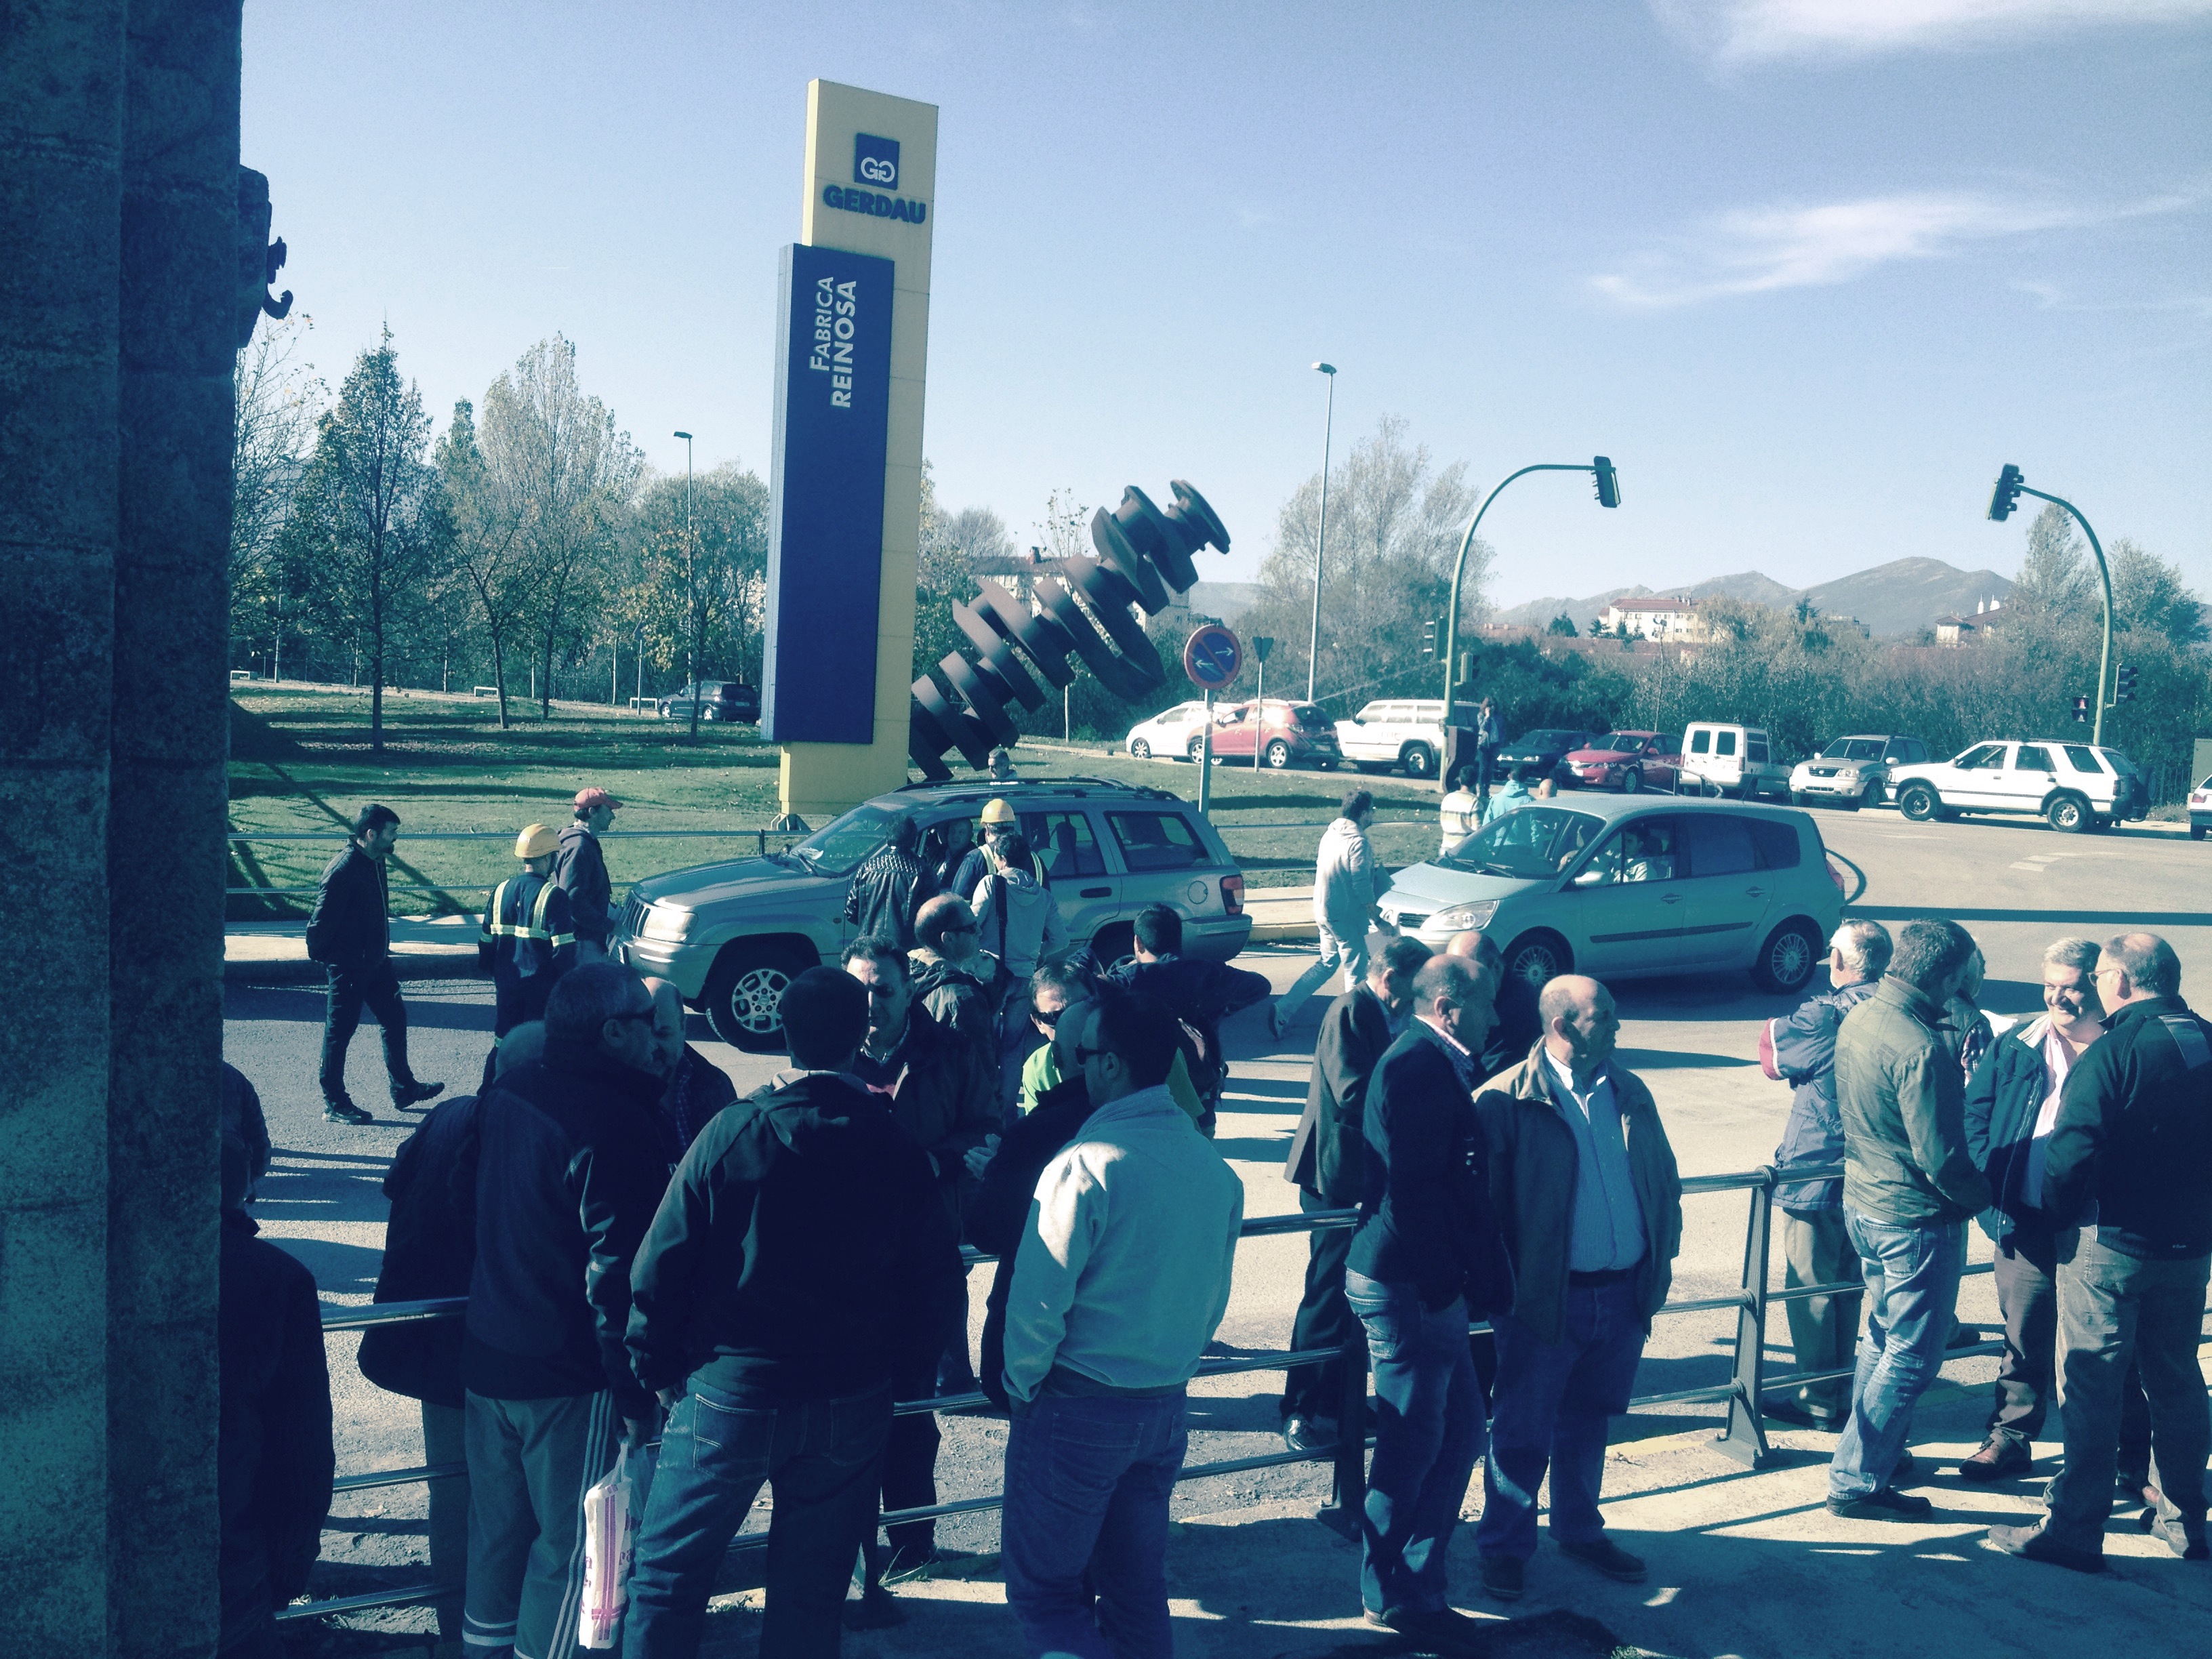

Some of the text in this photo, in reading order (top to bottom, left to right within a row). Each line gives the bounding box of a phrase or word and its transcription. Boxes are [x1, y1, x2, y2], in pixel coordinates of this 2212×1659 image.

[823, 184, 926, 224] GERDAU
[809, 276, 834, 371] FABRICA
[830, 280, 857, 408] REINOSA
